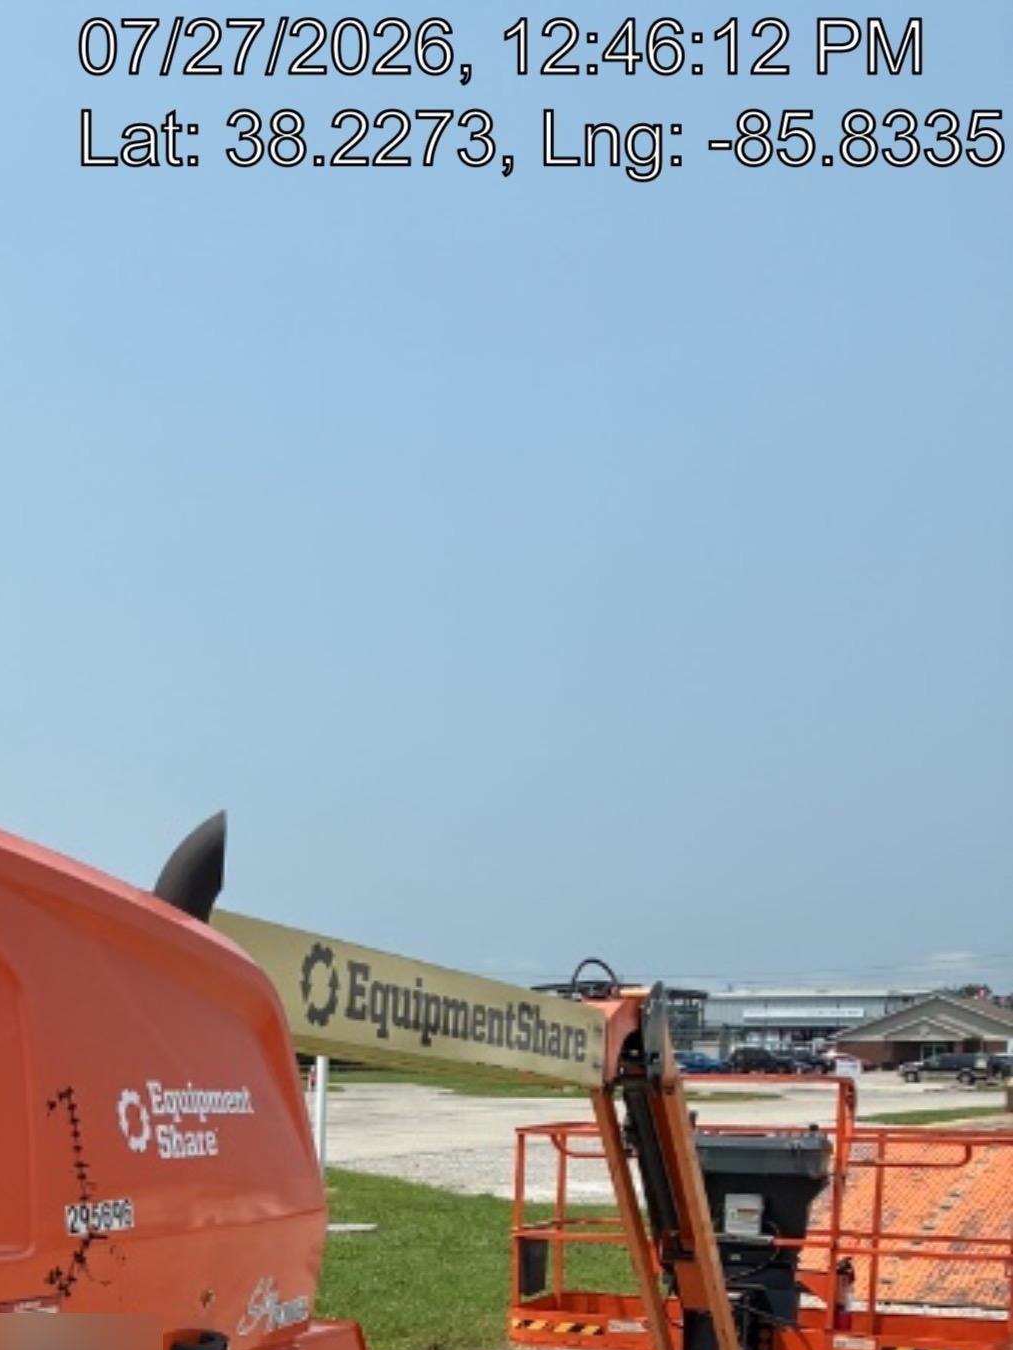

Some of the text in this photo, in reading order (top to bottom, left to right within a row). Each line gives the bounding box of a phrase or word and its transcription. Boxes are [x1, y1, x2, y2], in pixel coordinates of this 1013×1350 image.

[345, 959, 586, 1063] EquipmentShare
[146, 1080, 254, 1122] Equipment
[155, 1124, 219, 1159] Share
